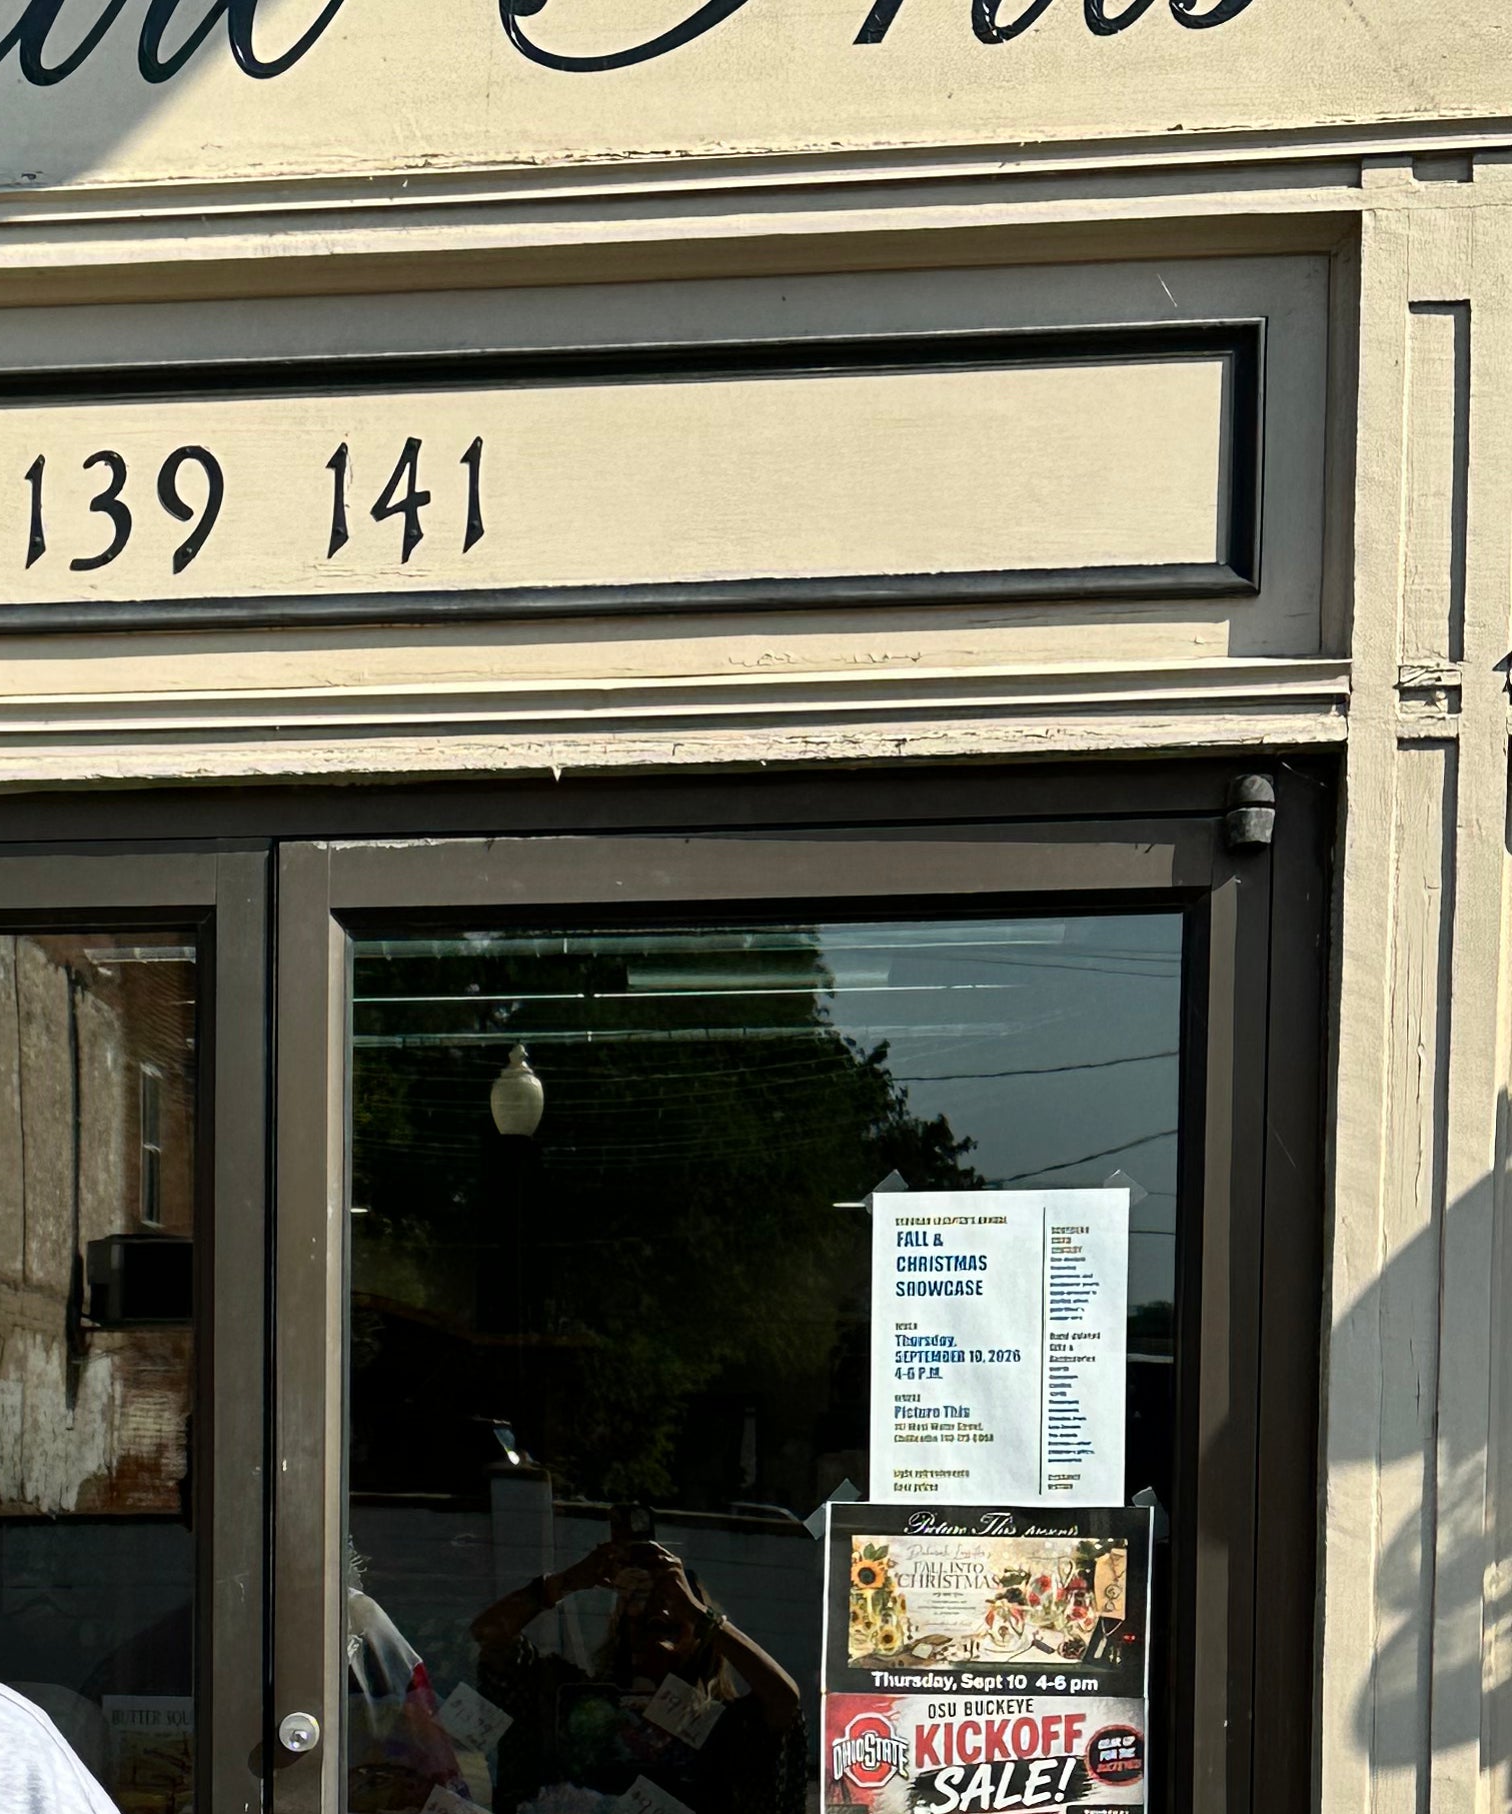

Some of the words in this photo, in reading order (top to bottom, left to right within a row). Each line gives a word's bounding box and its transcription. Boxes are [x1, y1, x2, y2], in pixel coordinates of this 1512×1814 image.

[24, 445, 225, 575] 139
[325, 434, 486, 565] 141
[896, 1230, 929, 1247] FALL
[933, 1233, 944, 1247] &
[896, 1255, 988, 1272] CHRISTMAS
[896, 1280, 984, 1297] SHOWCASE
[895, 1350, 965, 1363] SEPTEMBER
[894, 1405, 940, 1419] Picture
[943, 1405, 970, 1418] This
[972, 1512, 1016, 1535] This
[897, 1573, 1000, 1590] CHRISTMAS
[871, 1671, 958, 1692] Thursday,
[961, 1673, 1003, 1692] Sept
[1007, 1674, 1028, 1690] 10
[1035, 1675, 1066, 1690] 4-6
[1070, 1677, 1099, 1693] pm
[928, 1701, 956, 1719] OSU
[964, 1698, 1034, 1717] BUCKEYE
[914, 1713, 1087, 1769] KICKOFF
[833, 1739, 865, 1781] OHIO
[863, 1733, 909, 1780] STATE
[930, 1757, 1077, 1814] SALE!
